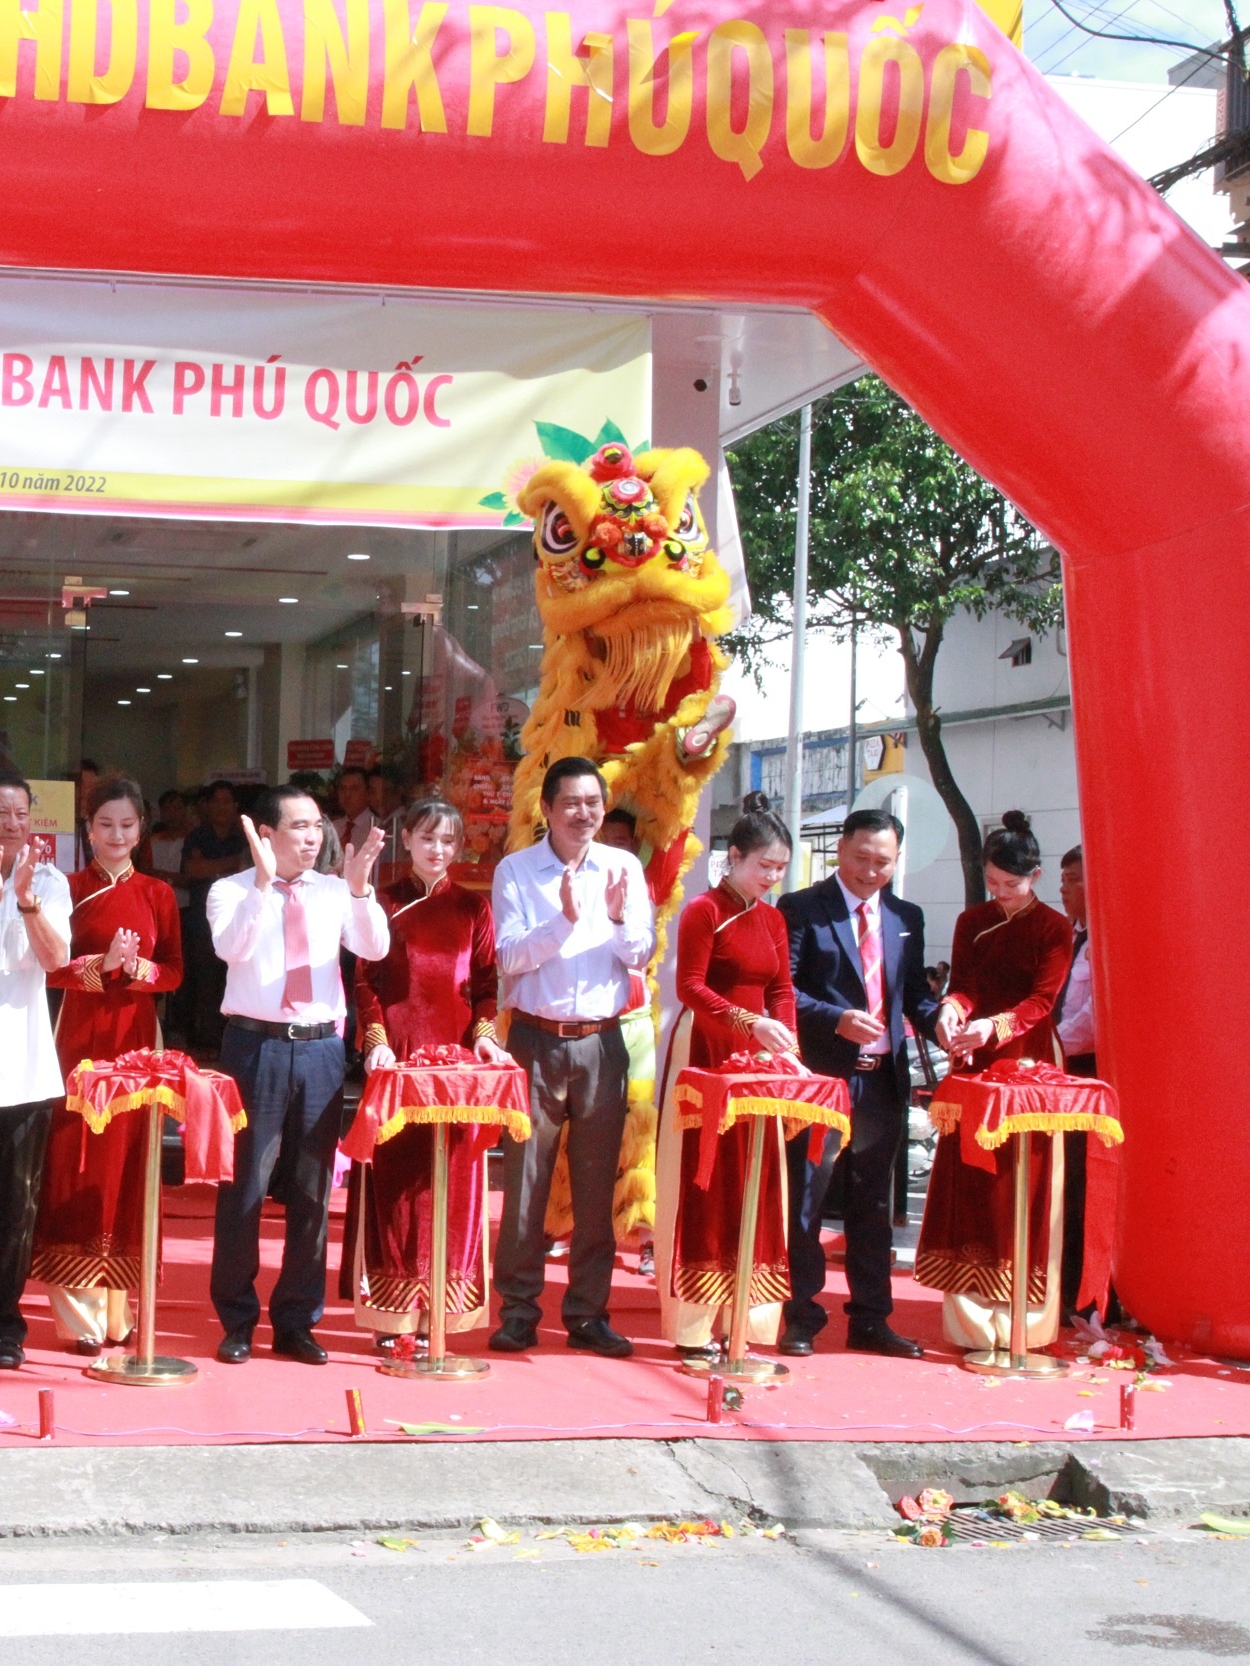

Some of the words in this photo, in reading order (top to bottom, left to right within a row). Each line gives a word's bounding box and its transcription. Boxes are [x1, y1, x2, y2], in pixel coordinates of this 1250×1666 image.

[466, 0, 703, 156] PHÚ
[706, 3, 992, 183] QUỐC
[172, 353, 287, 420] PHÚ
[303, 355, 454, 431] QUỐC
[0, 471, 20, 489] 10
[22, 472, 61, 491] năm
[63, 474, 107, 493] 2022
